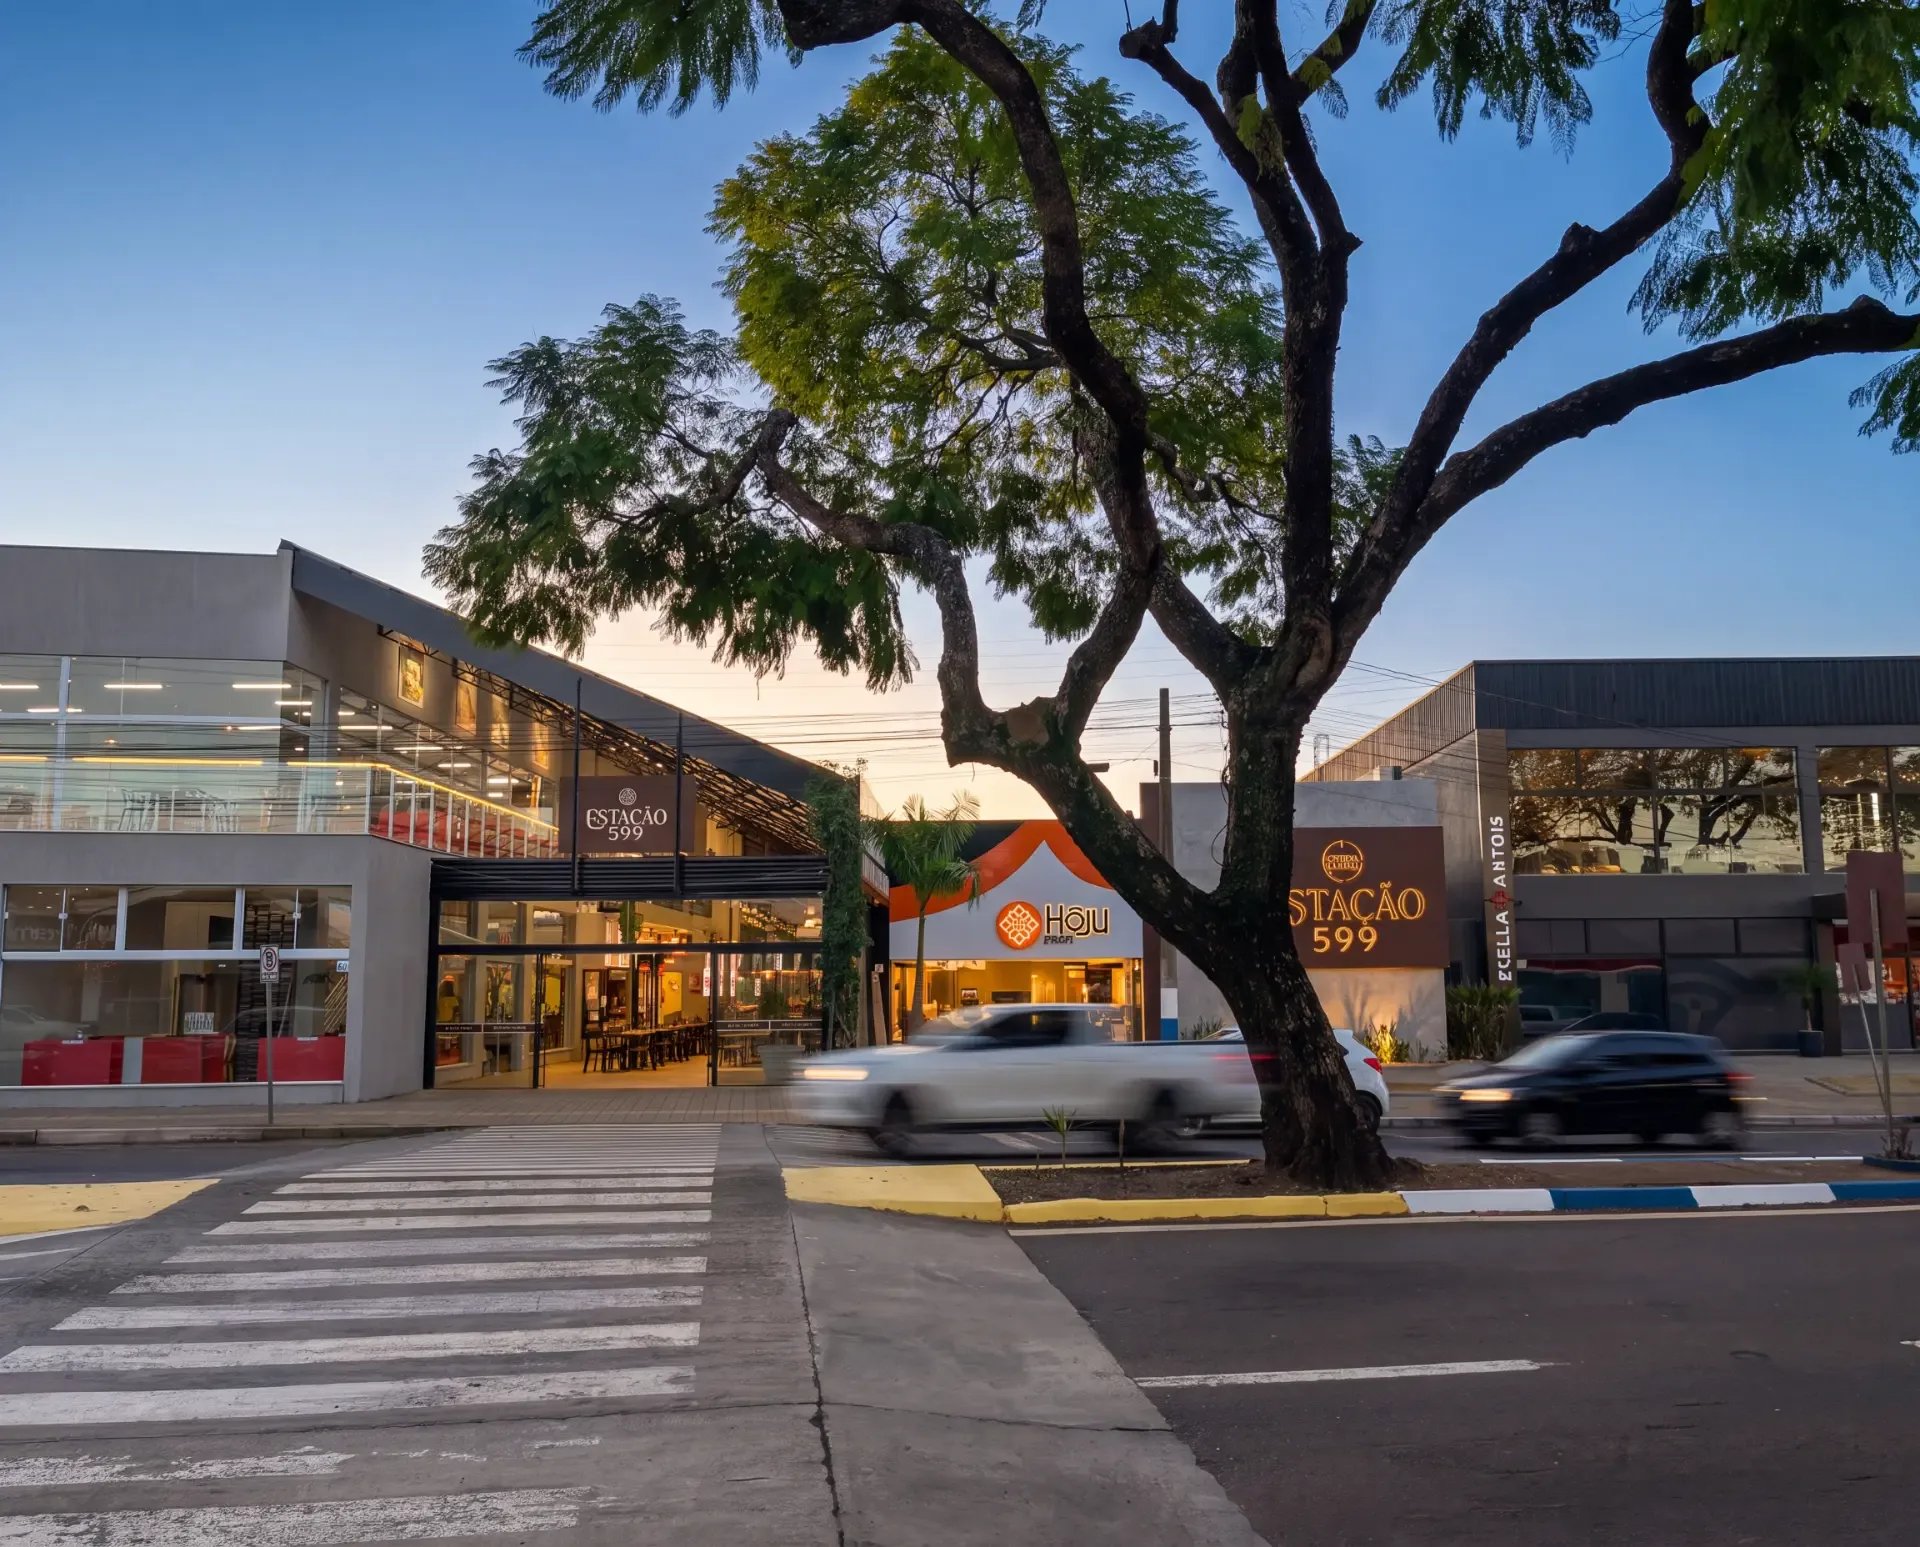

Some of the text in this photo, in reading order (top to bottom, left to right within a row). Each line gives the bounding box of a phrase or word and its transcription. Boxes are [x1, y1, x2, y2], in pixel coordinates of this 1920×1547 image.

[608, 826, 643, 841] 599
[1288, 880, 1426, 926] STAÇÃO
[1313, 926, 1378, 953] 599
